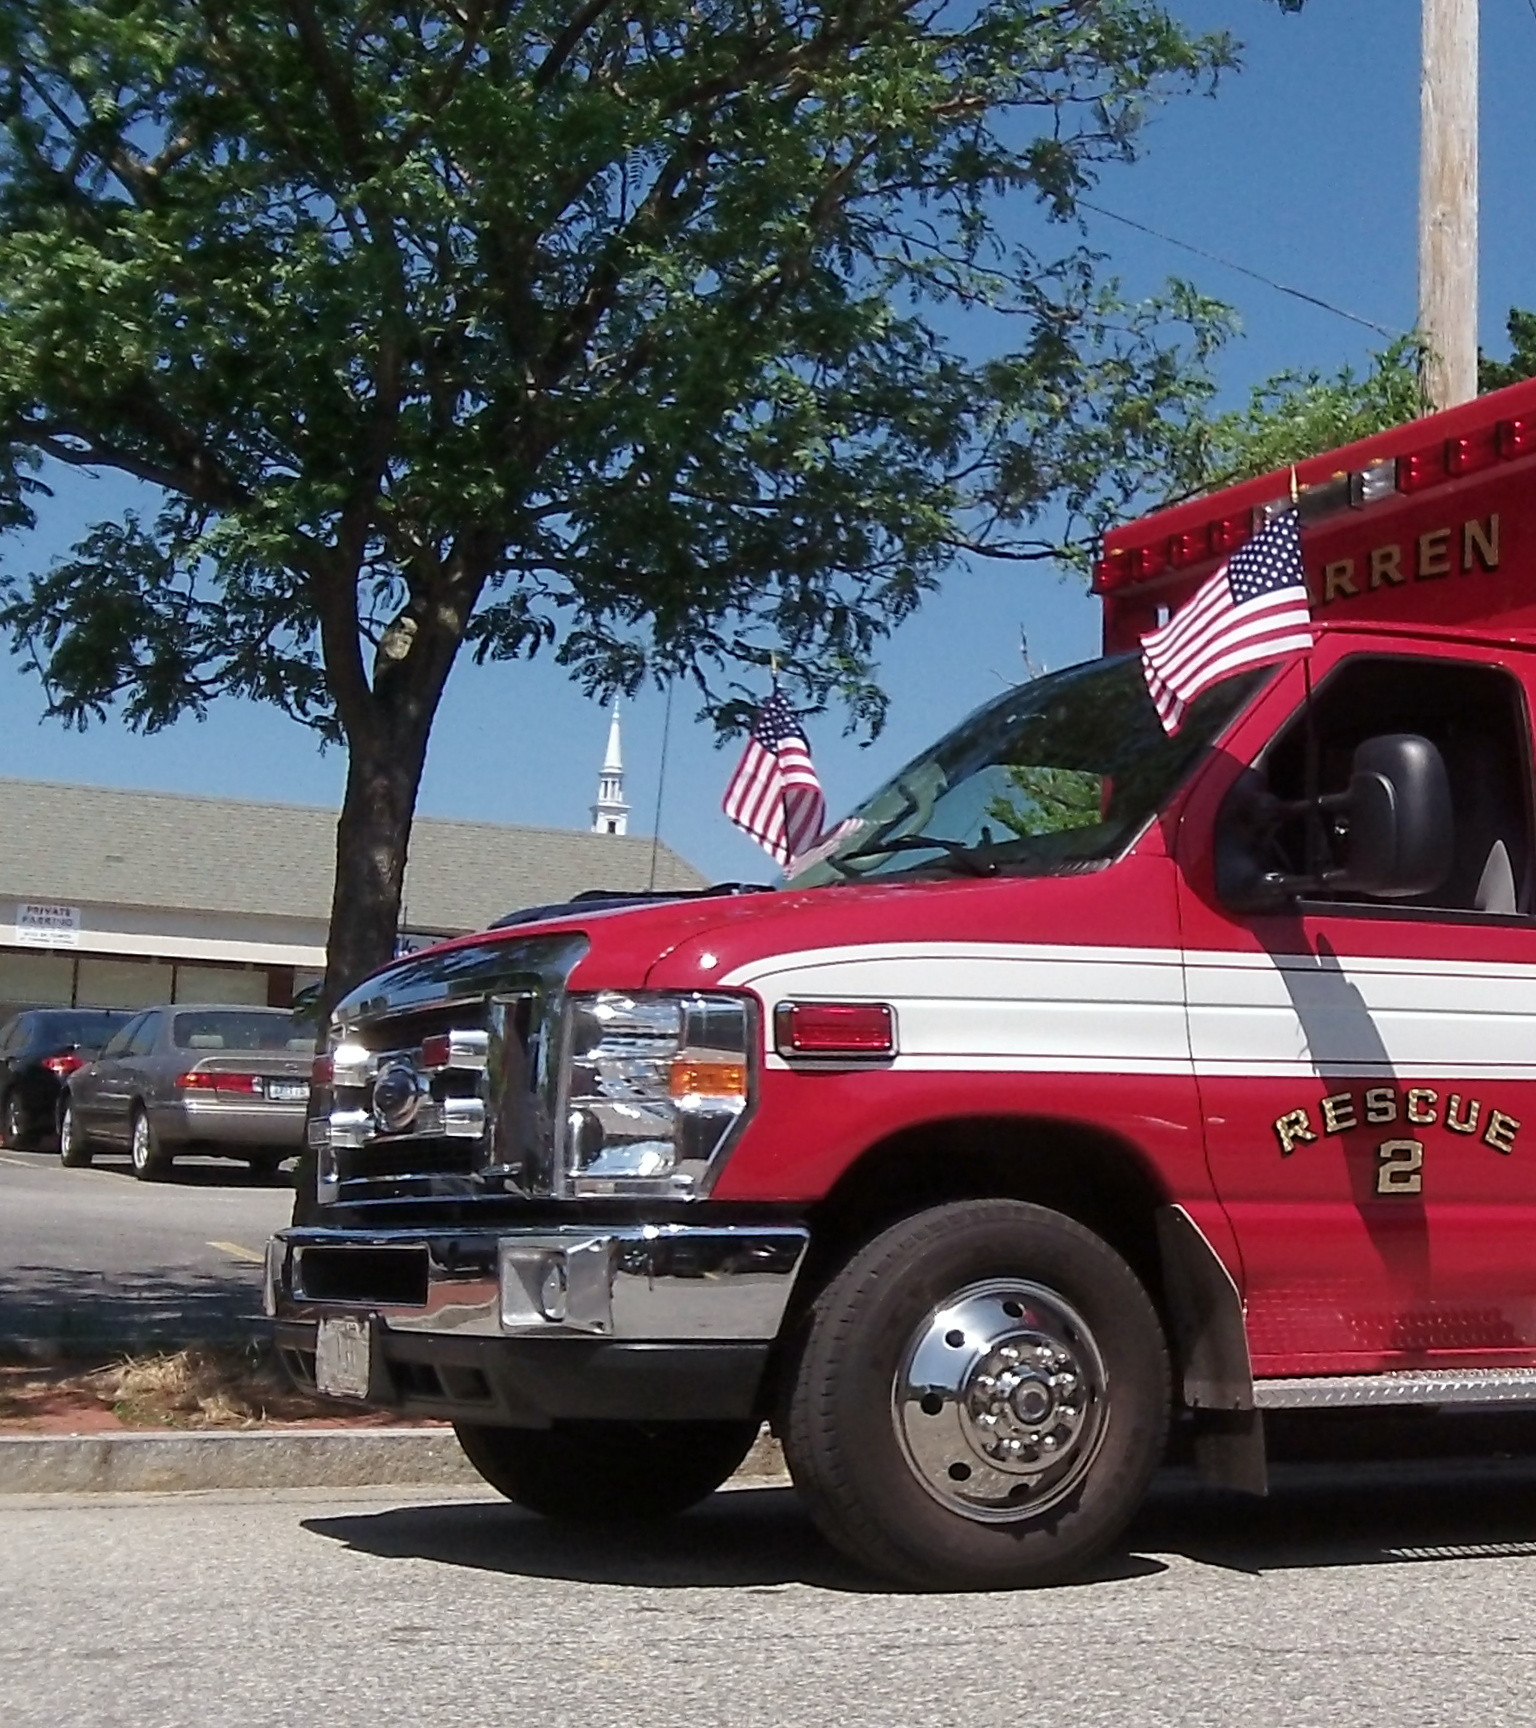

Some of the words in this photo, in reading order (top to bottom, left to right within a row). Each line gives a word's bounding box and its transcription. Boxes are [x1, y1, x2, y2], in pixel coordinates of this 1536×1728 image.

[1307, 512, 1501, 607] RREN
[27, 905, 71, 917] PRIVATE
[1274, 1086, 1522, 1155] RESCUE
[1376, 1138, 1424, 1194] 2
